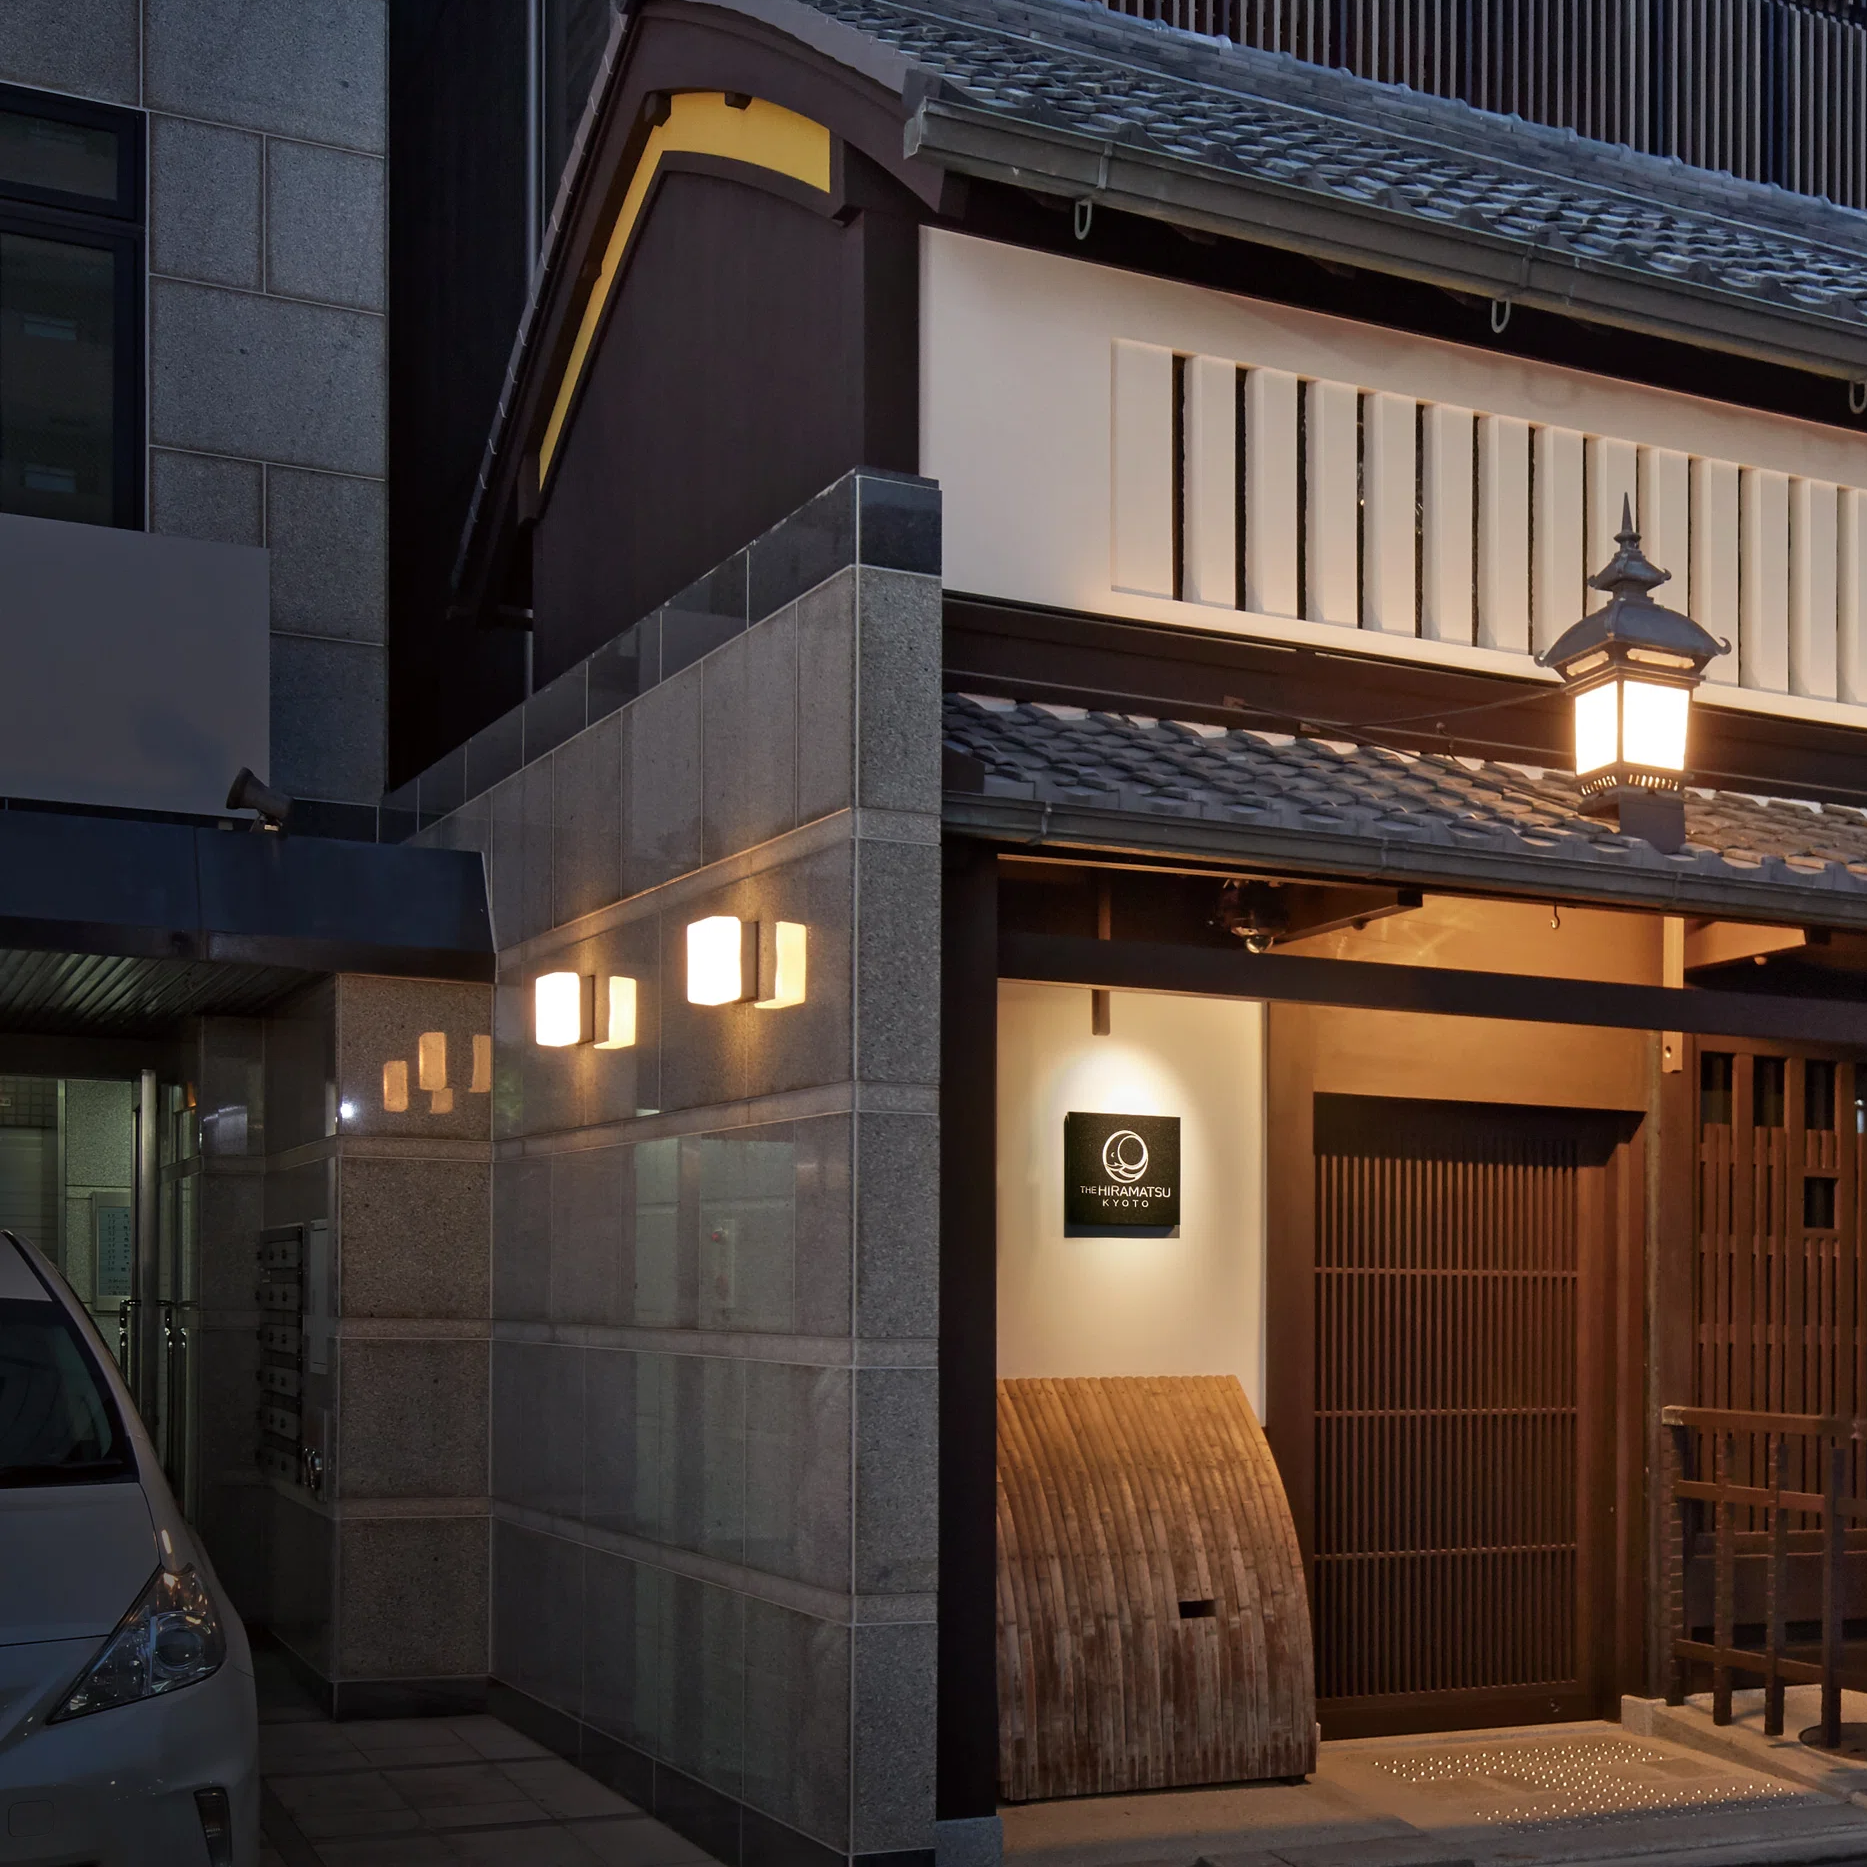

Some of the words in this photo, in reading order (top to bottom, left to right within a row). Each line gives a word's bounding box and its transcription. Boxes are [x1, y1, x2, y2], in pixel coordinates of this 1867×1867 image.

[1080, 1185, 1097, 1195] THE
[1098, 1185, 1171, 1198] HIRAMATSU
[1102, 1199, 1149, 1208] KYOTO
